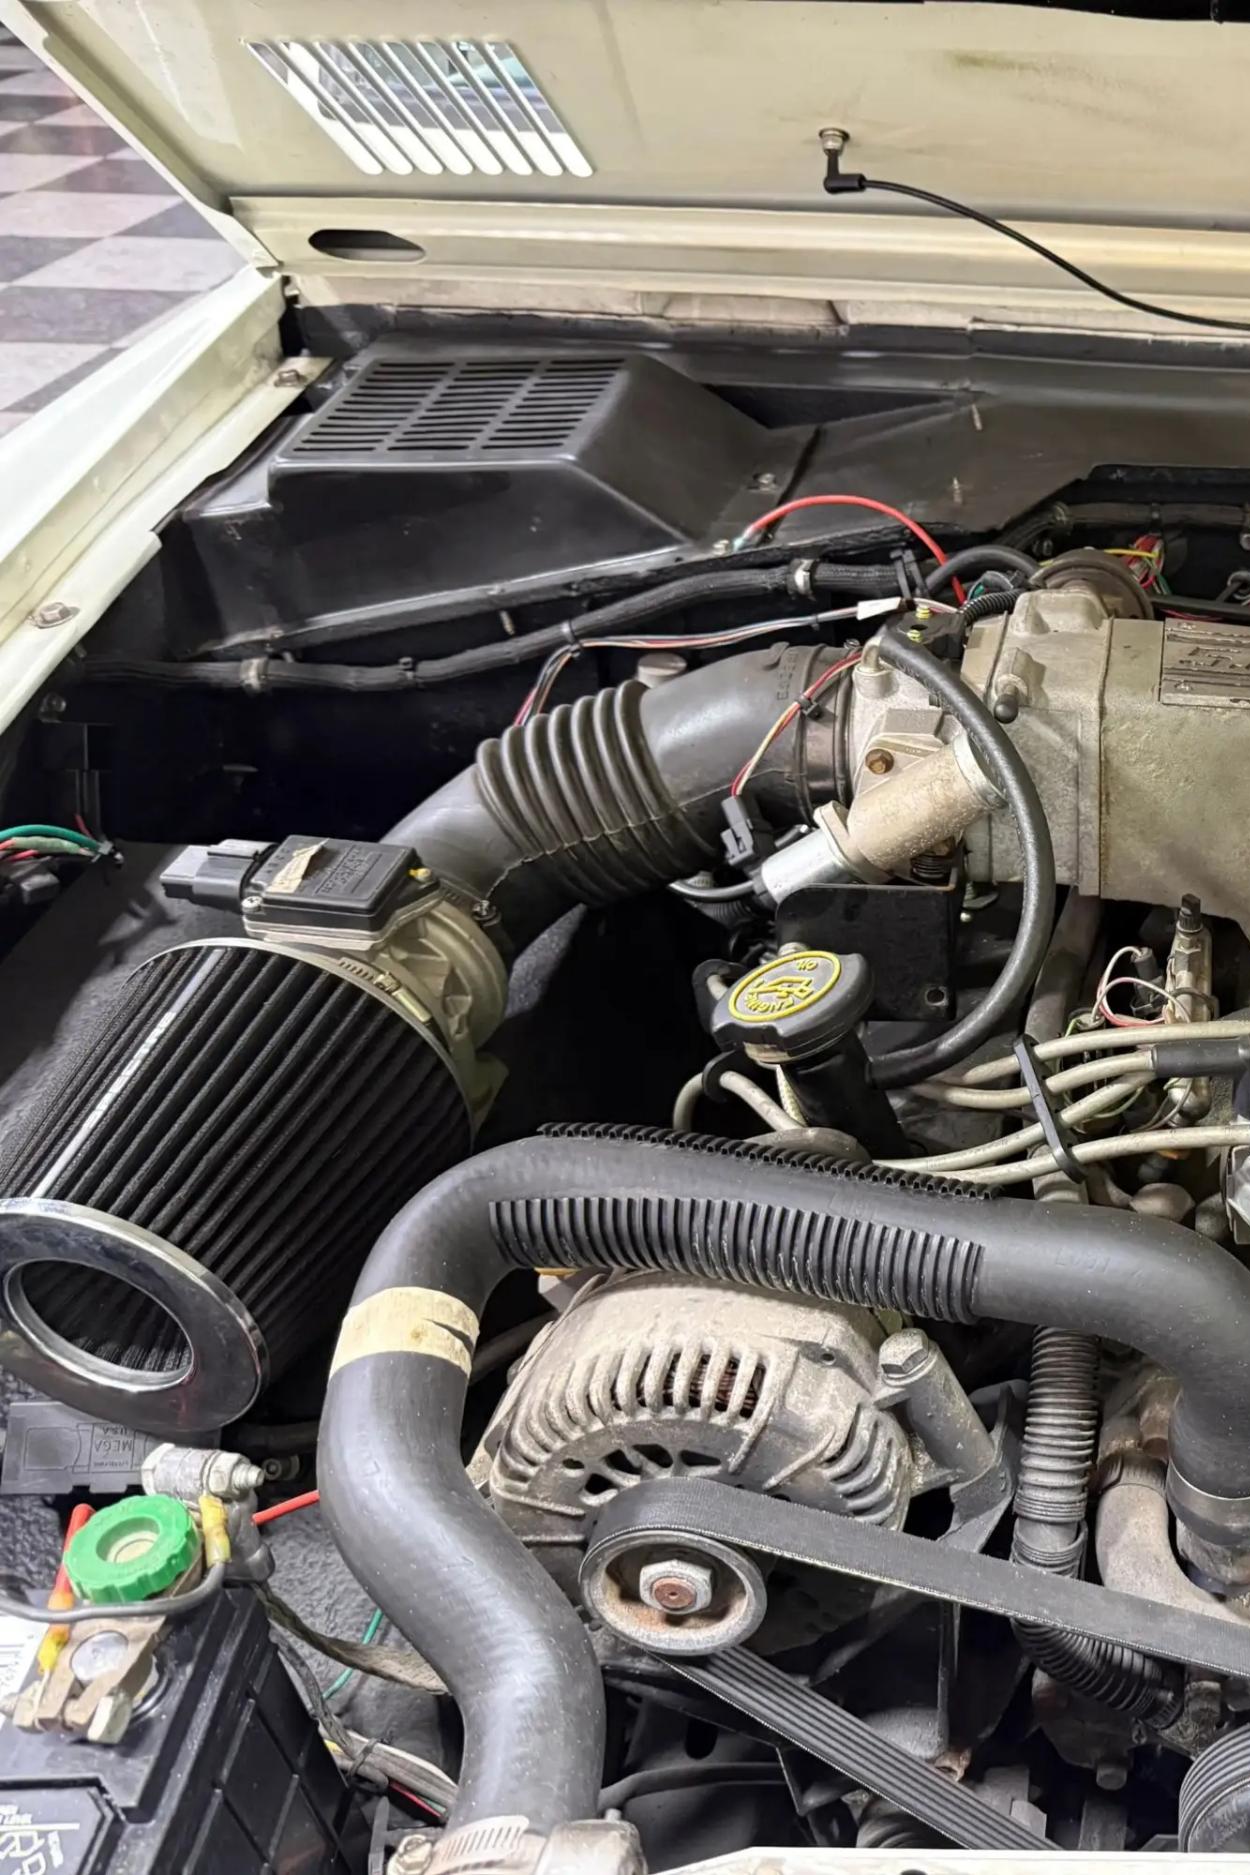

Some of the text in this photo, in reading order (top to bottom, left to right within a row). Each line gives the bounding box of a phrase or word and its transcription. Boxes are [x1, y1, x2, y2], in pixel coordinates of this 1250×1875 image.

[796, 959, 818, 972] OIL
[744, 988, 795, 1013] ENGINE
[94, 1439, 133, 1452] MEGA
